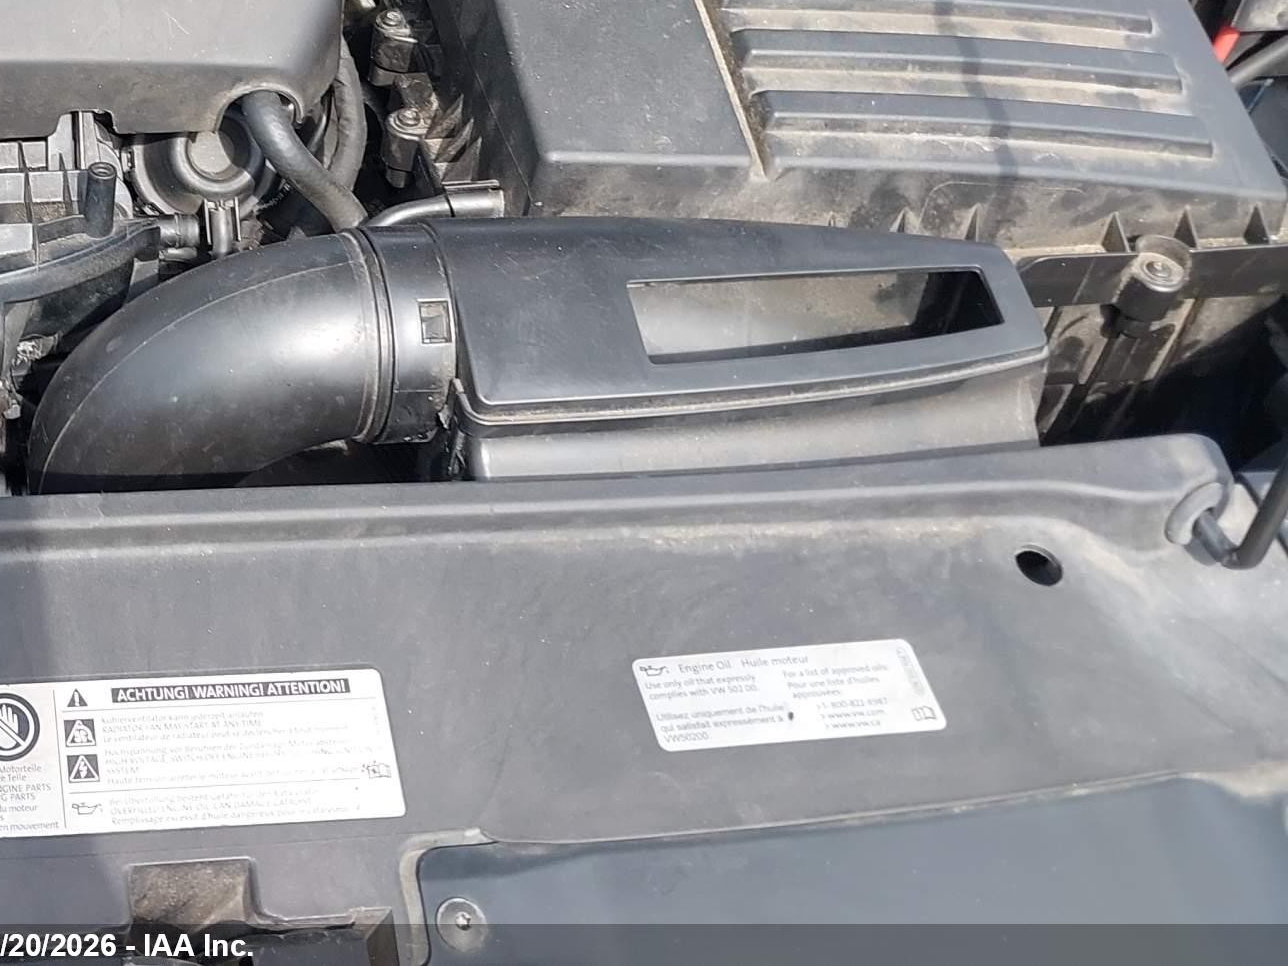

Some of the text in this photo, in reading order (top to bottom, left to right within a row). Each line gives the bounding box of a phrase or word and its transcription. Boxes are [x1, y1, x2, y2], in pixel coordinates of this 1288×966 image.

[678, 655, 808, 674] Engine Oil Huile moteur
[645, 674, 756, 690] Use only oil that expressly
[117, 679, 346, 701] ACHTUNG! WARNING! ATTENTION!
[649, 691, 688, 702] complies
[690, 688, 709, 698] with
[710, 687, 726, 695] VW
[8, 772, 27, 782] Teile
[26, 782, 52, 792] PARTS
[10, 792, 36, 802] PARTS
[9, 804, 38, 812] moteur
[9, 820, 60, 831] mouvement
